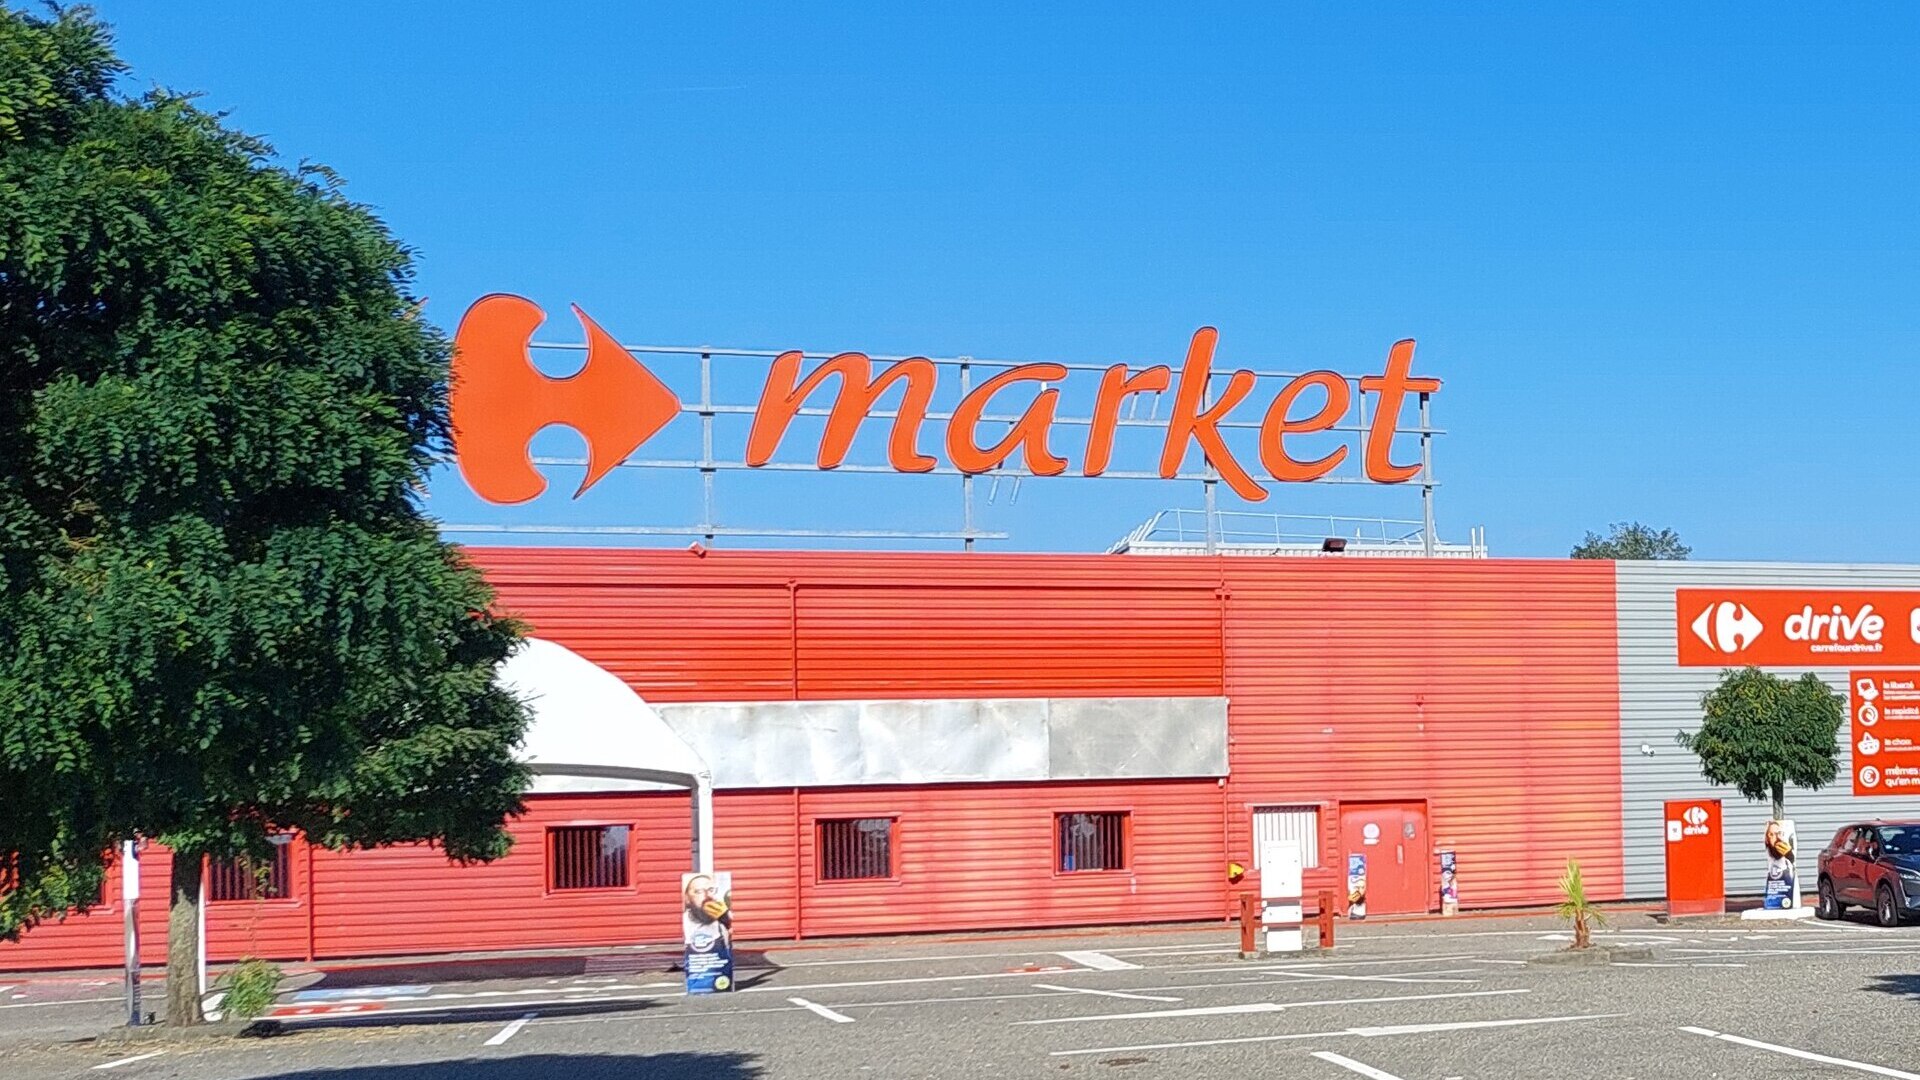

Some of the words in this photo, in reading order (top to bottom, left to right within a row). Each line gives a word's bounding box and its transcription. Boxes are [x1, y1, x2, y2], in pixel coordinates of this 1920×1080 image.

[745, 326, 1443, 502] market
[1784, 604, 1884, 641] drive
[1885, 763, 1918, 775] mêmes
[1684, 824, 1709, 835] drive
